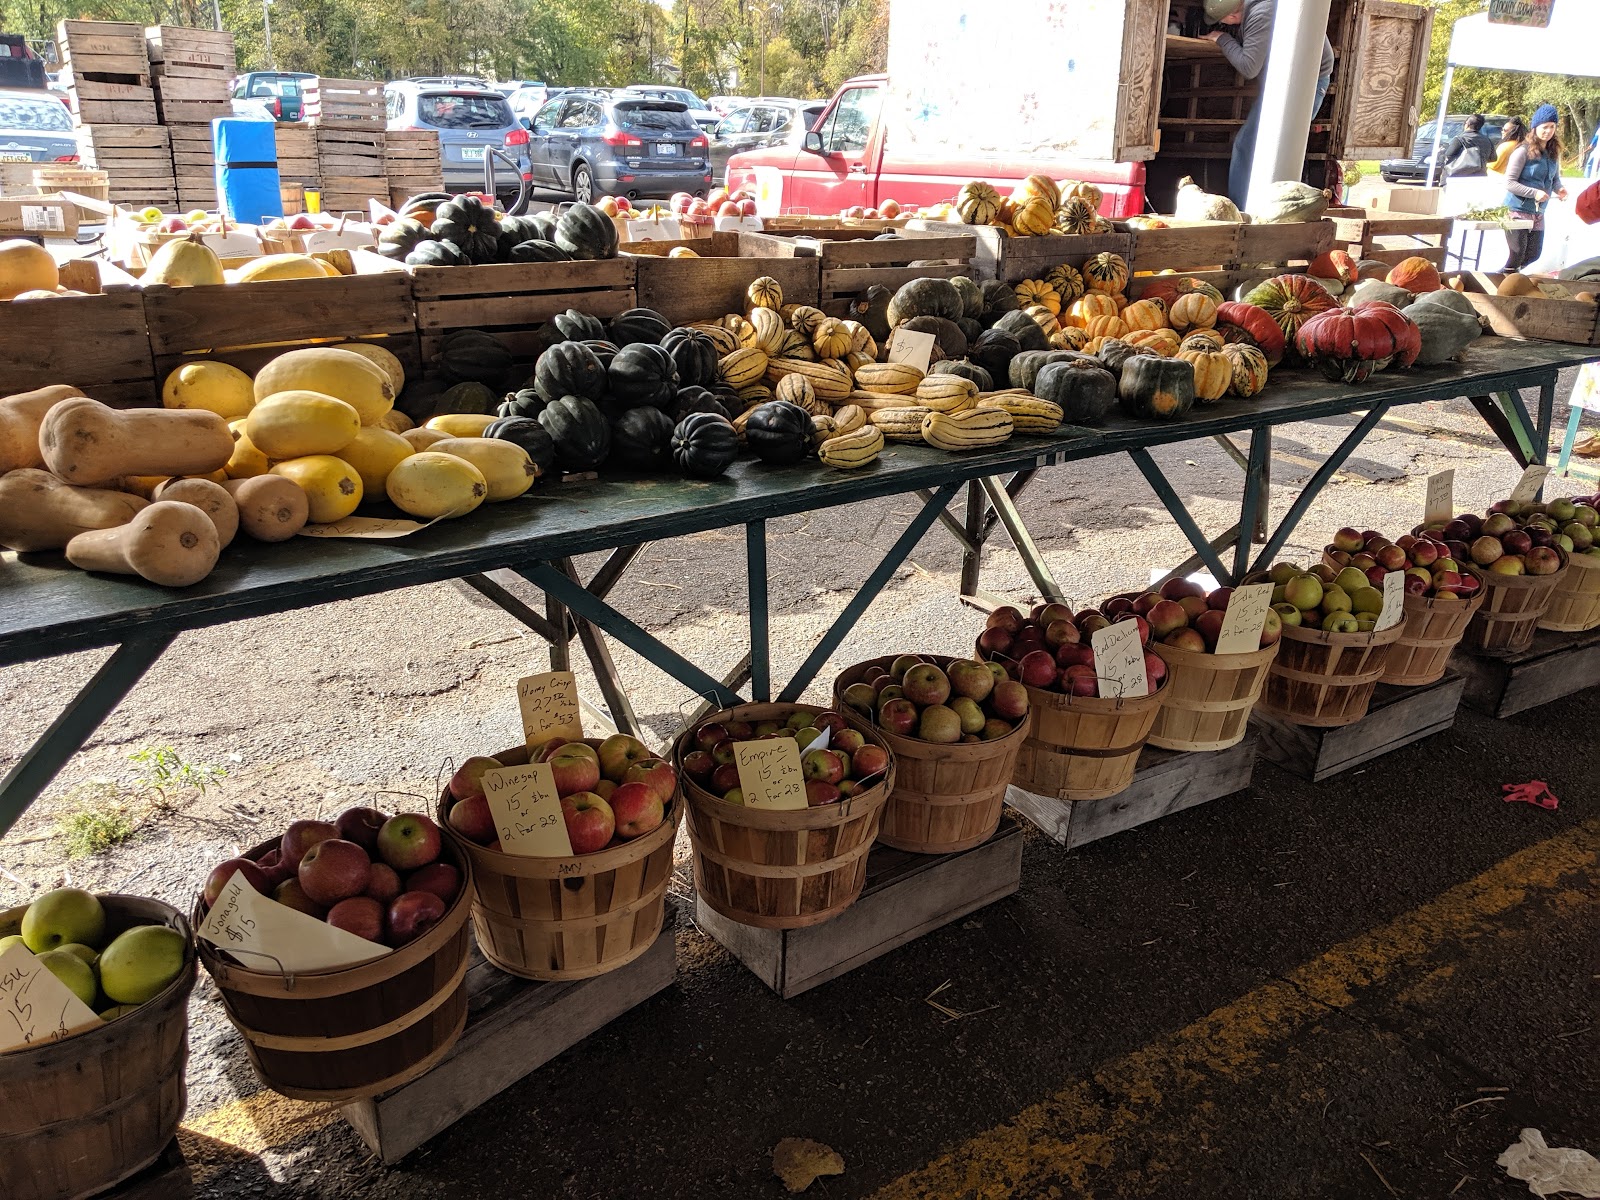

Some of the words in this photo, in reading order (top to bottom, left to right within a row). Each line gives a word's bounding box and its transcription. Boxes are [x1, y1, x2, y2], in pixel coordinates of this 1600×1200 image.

[521, 683, 546, 698] Honey
[549, 677, 572, 691] Crisp
[525, 725, 536, 739] 2
[739, 744, 788, 767] Empire
[487, 769, 538, 792] Winesap
[748, 792, 759, 804] 2
[784, 783, 800, 796] 28
[520, 808, 529, 817] or
[502, 827, 516, 841] 2
[539, 814, 558, 829] 28
[207, 883, 243, 935] Jonagold
[224, 915, 256, 943] $15
